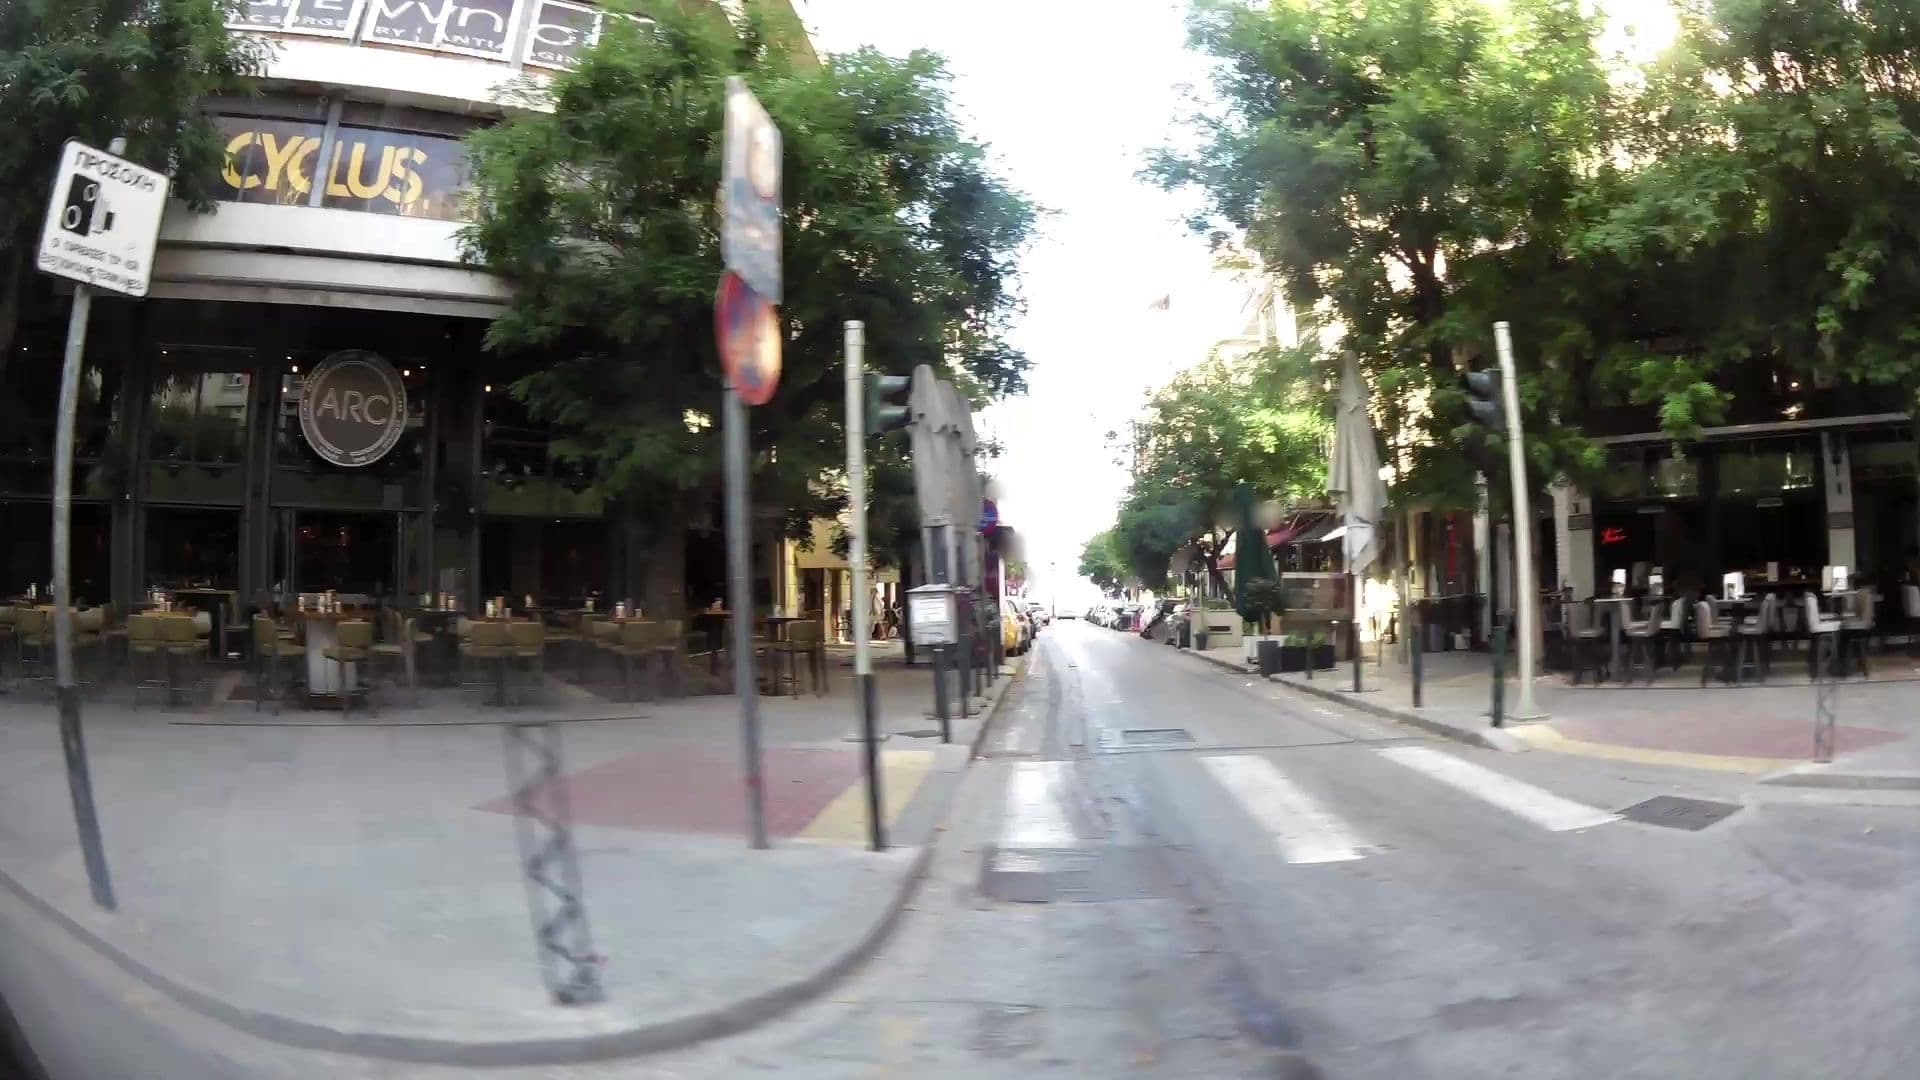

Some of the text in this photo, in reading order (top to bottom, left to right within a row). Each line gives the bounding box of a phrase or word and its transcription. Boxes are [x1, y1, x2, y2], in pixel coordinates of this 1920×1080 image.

[74, 151, 156, 193] ΠΡΟΣΟΧΗ
[222, 131, 428, 204] CYCLUS
[316, 387, 390, 426] ARC
